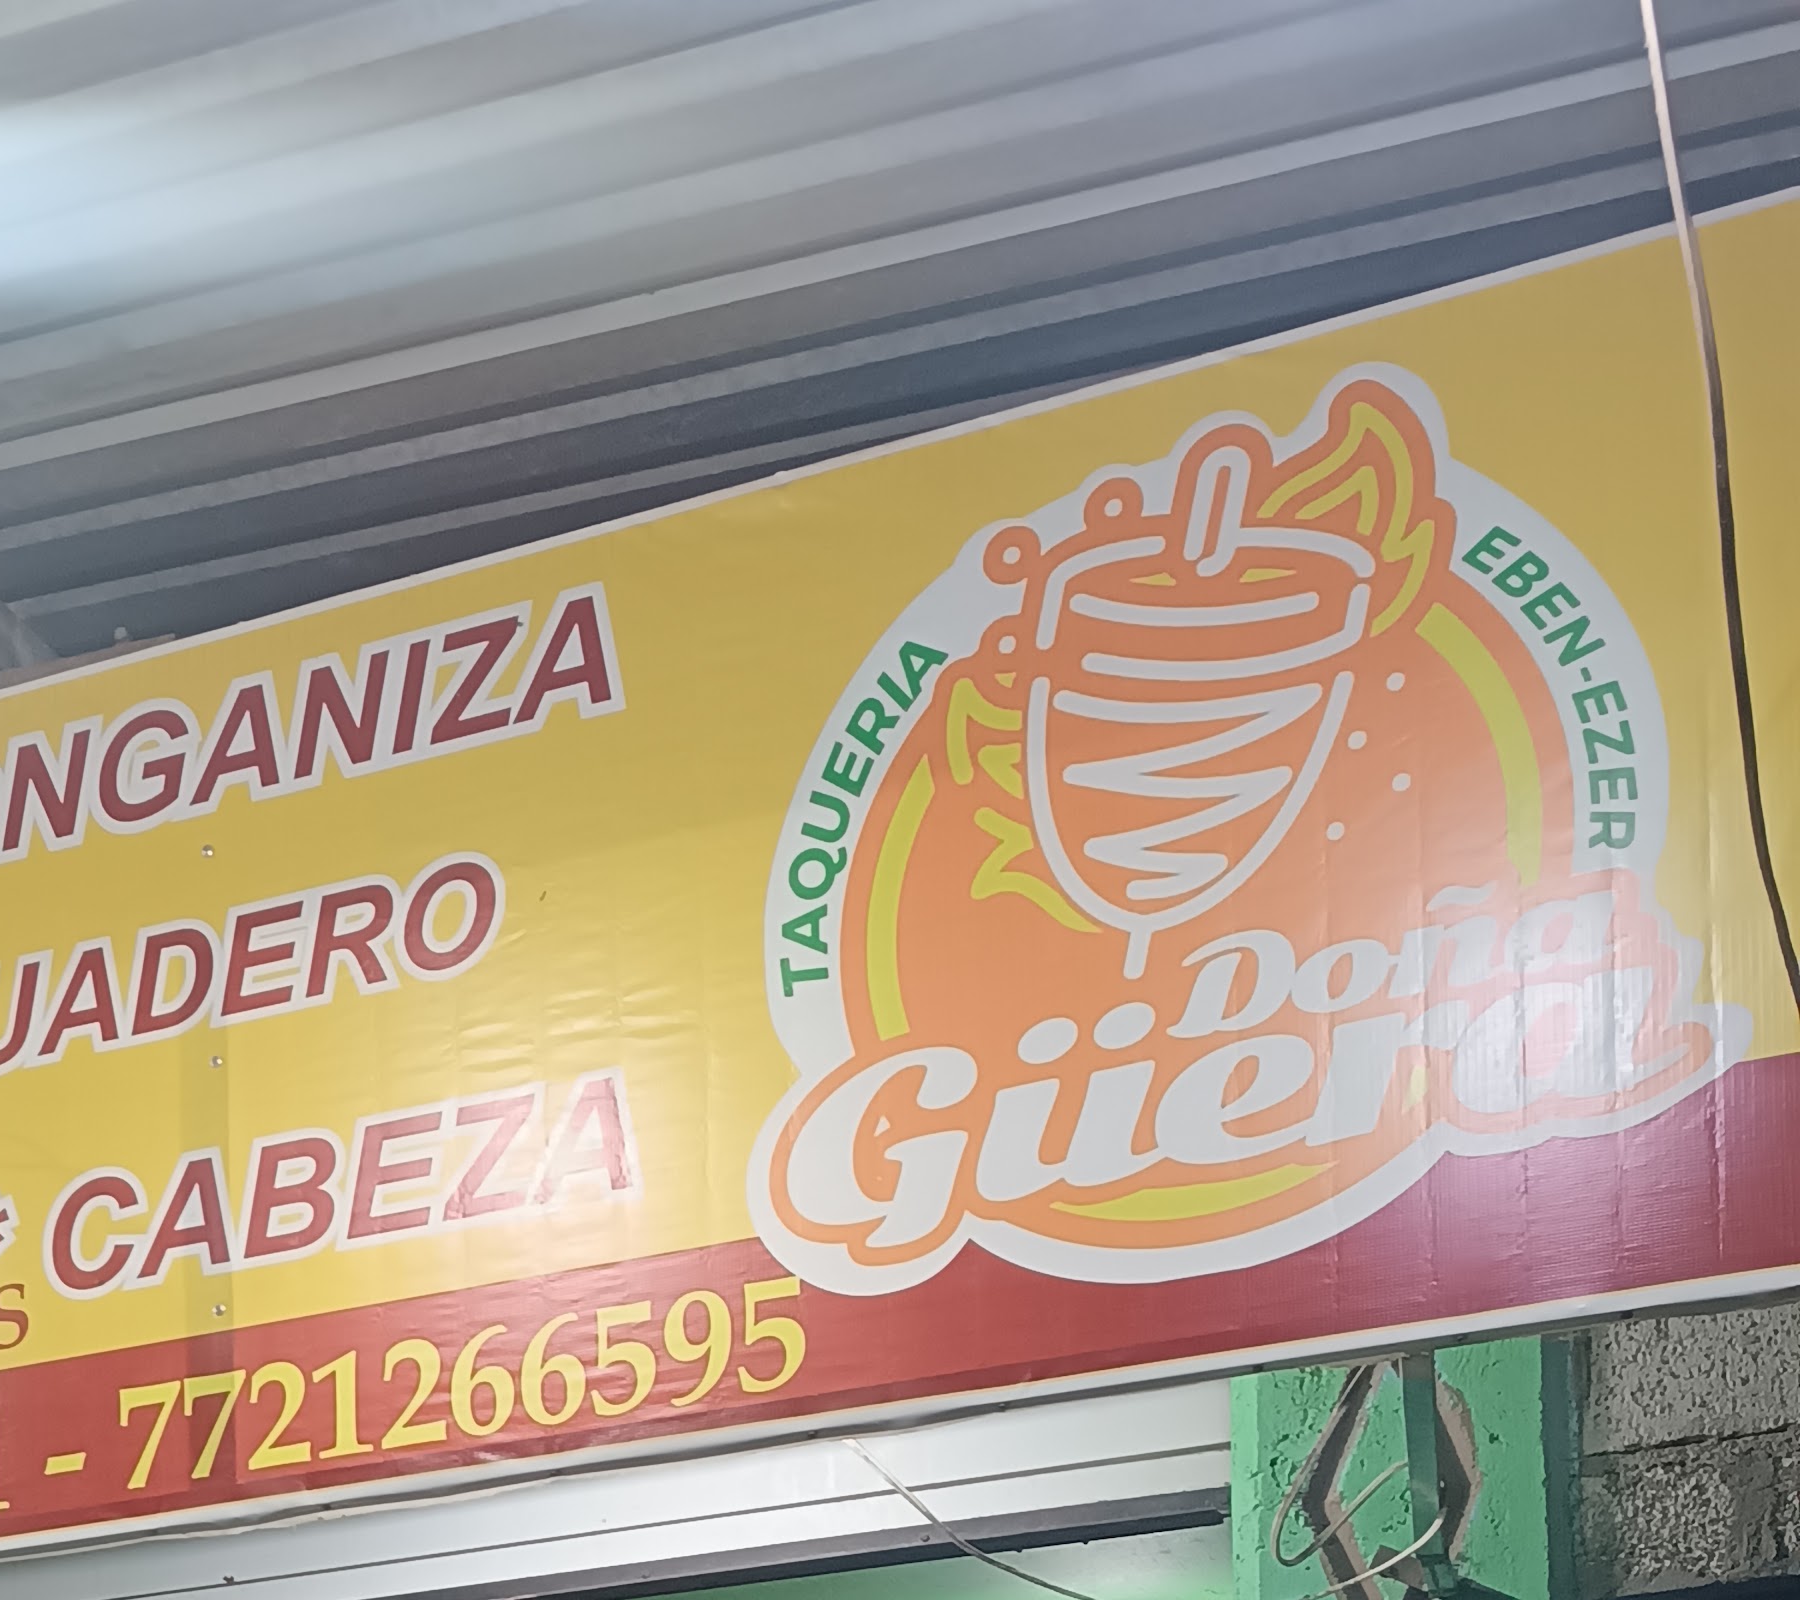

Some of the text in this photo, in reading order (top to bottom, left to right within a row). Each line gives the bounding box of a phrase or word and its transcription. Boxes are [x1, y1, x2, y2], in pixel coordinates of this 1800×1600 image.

[779, 639, 950, 999] TAQUERIA
[1461, 526, 1636, 850] EBEN-EZER
[1168, 884, 1647, 1038] Doña
[787, 966, 1720, 1248] Güera
[119, 1275, 807, 1490] 7721266595
